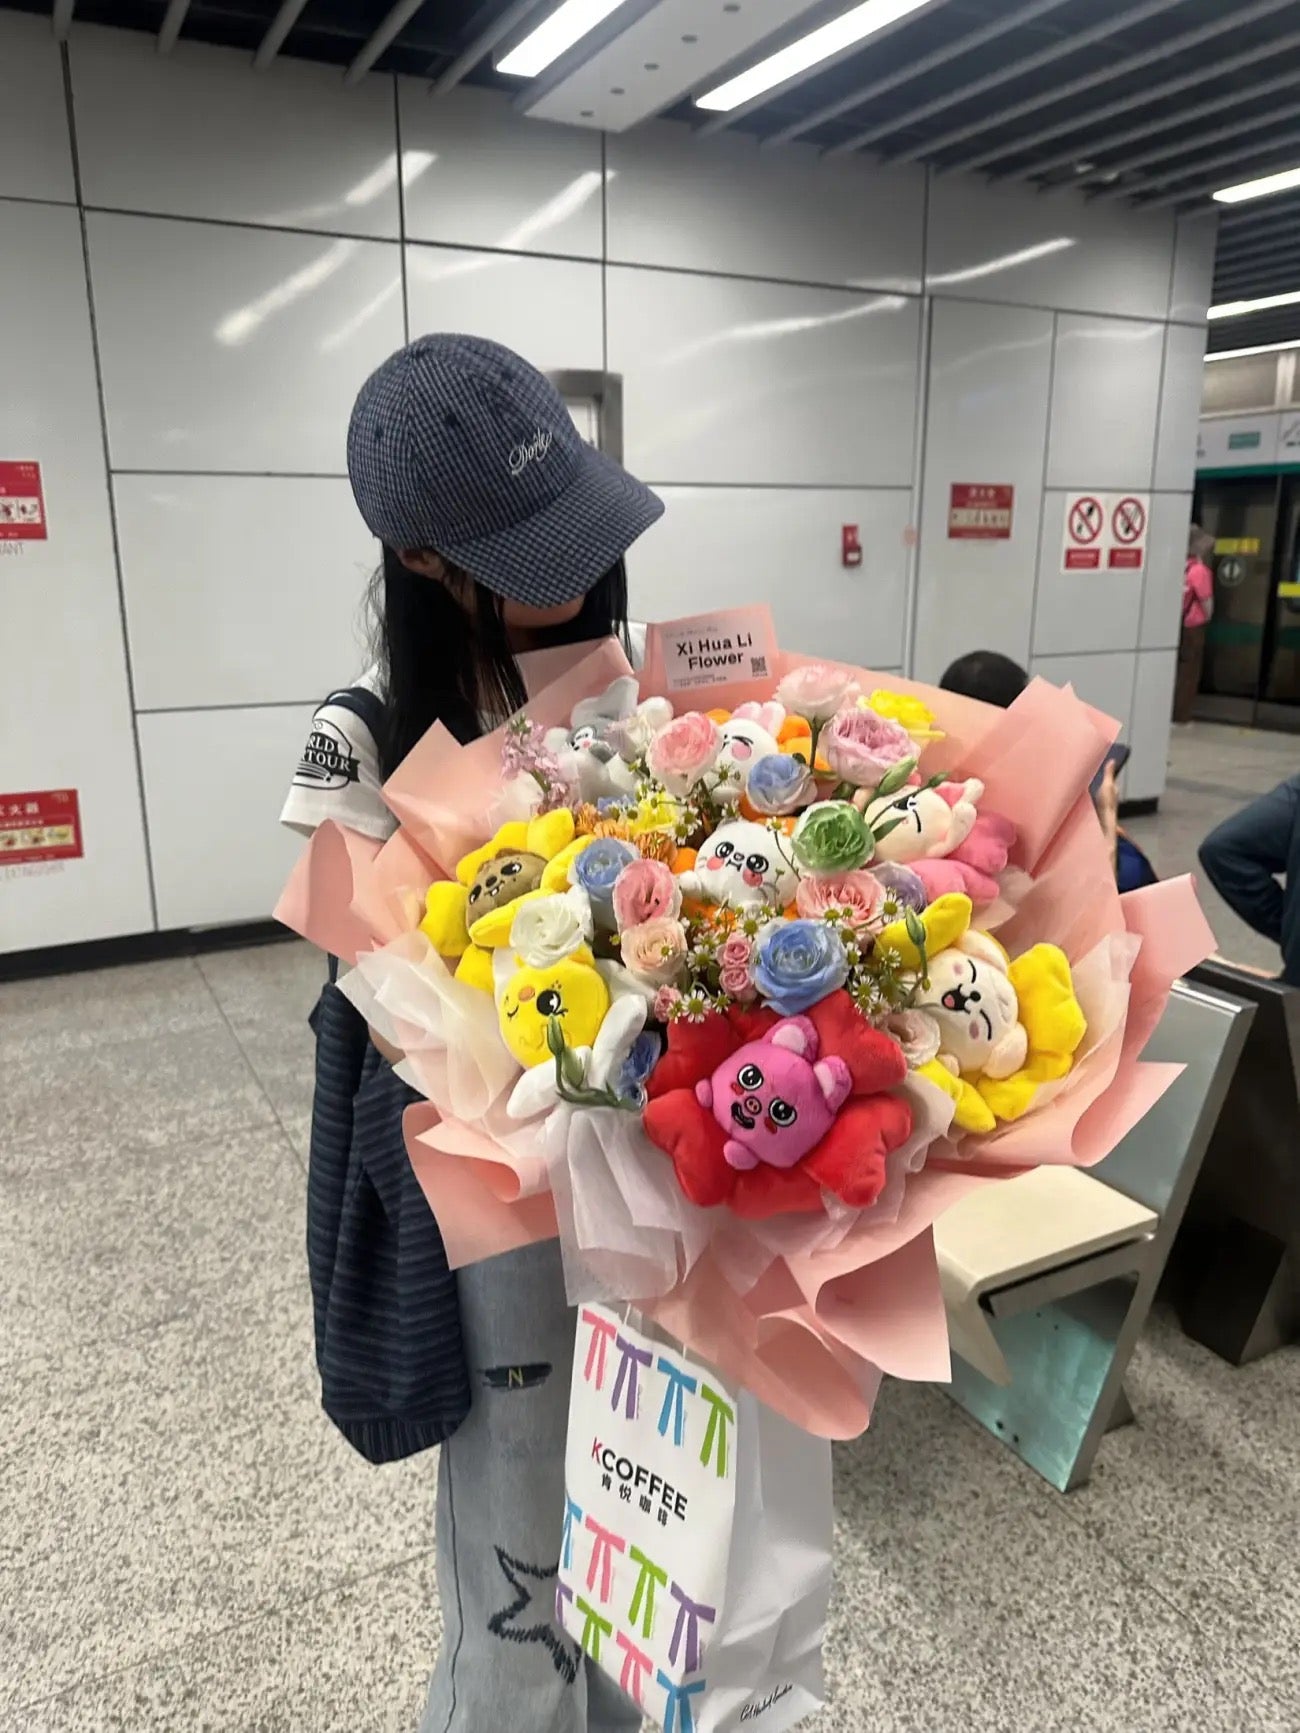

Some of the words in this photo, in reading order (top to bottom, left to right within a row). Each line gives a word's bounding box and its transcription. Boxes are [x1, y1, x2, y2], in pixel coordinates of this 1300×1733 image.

[676, 641, 693, 656] Xi
[698, 637, 732, 653] Hua
[737, 632, 753, 648] Li
[688, 652, 744, 670] Flower
[306, 748, 350, 772] TOUR
[508, 1367, 524, 1388] N
[591, 1437, 688, 1521] KCOFFEE
[601, 1473, 669, 1527] 肯悦咖啡
